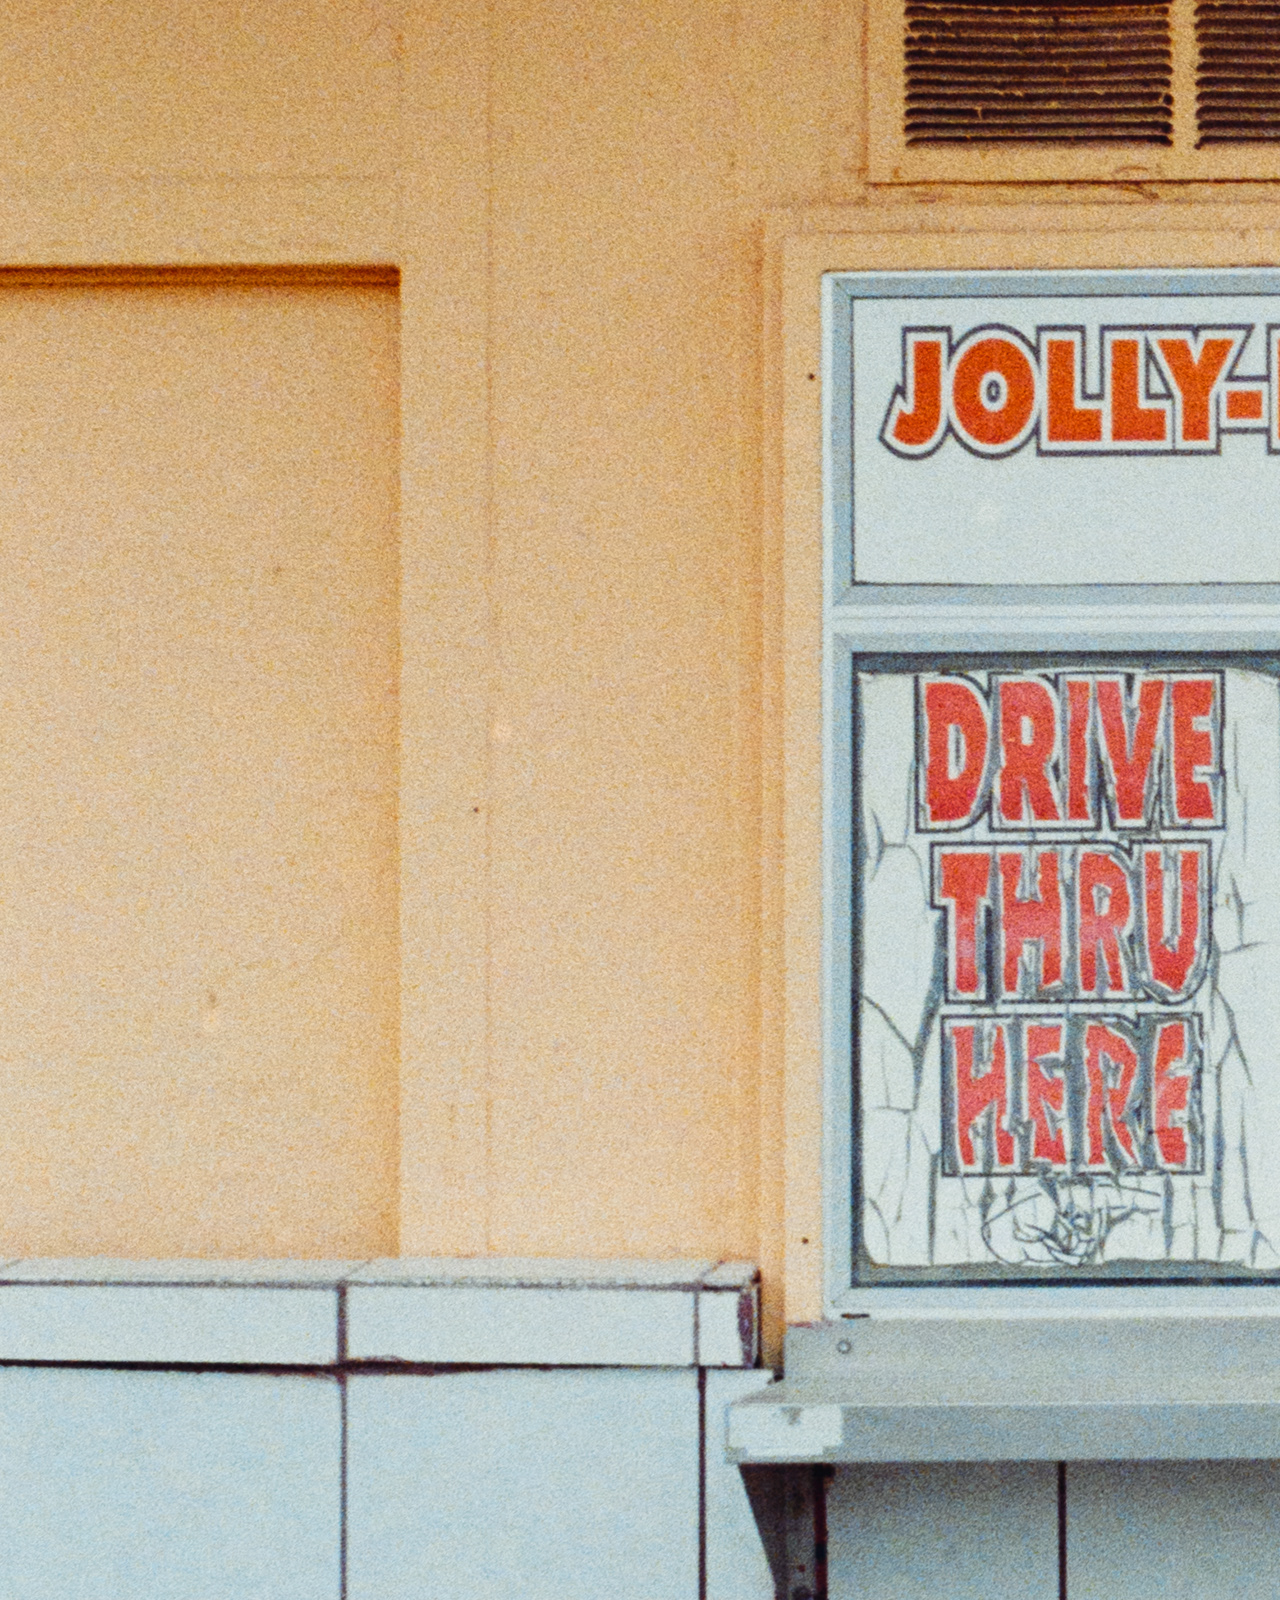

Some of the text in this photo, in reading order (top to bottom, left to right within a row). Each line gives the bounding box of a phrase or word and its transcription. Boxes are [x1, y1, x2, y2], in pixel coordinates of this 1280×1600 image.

[917, 673, 1225, 831] DRIVE
[932, 842, 1212, 1003] THRU
[944, 1014, 1202, 1174] HERE
